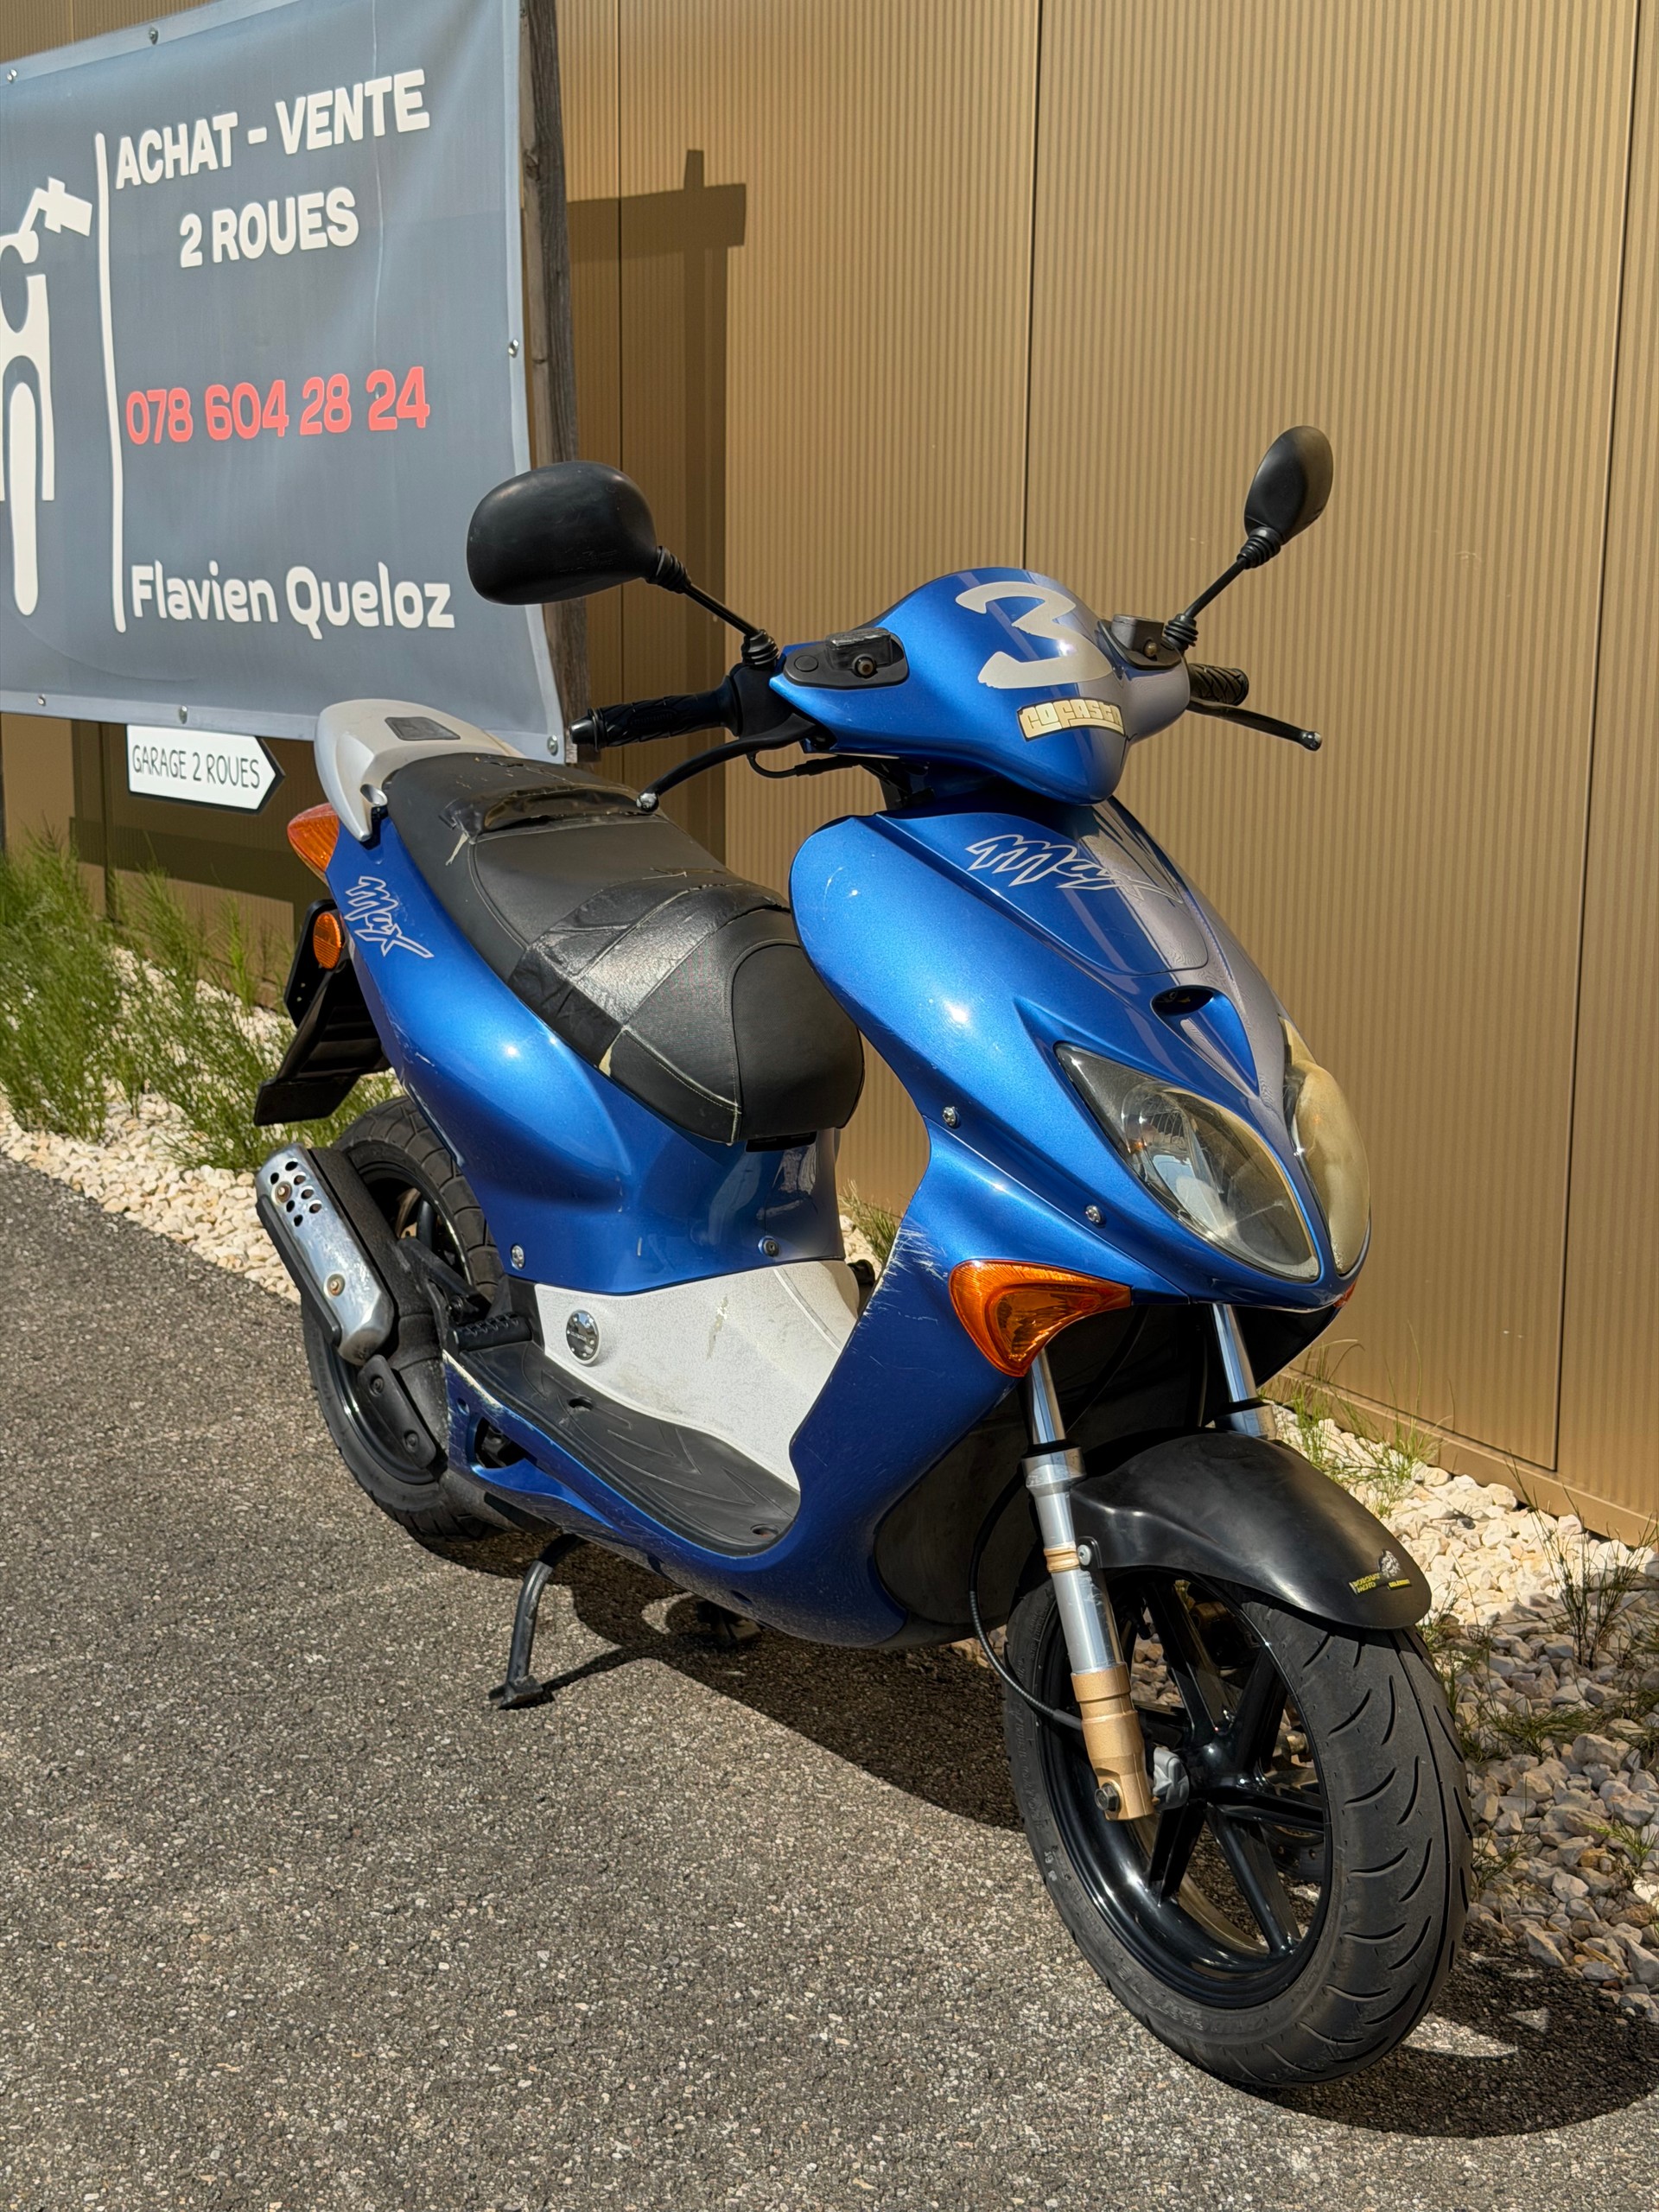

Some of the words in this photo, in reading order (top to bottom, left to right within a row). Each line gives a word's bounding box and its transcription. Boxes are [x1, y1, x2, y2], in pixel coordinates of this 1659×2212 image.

[115, 111, 238, 190] ACHAT
[275, 68, 430, 155] VENTE
[180, 213, 203, 268] 2
[212, 187, 359, 264] ROUES
[125, 387, 193, 445] 078
[204, 379, 289, 442] 604
[299, 373, 352, 435] 28
[365, 365, 430, 431] 24
[130, 560, 278, 624] Flavien
[286, 561, 455, 639] Queloz
[132, 744, 187, 780] GARAGE
[192, 752, 202, 782] 2
[206, 753, 260, 790] ROUES
